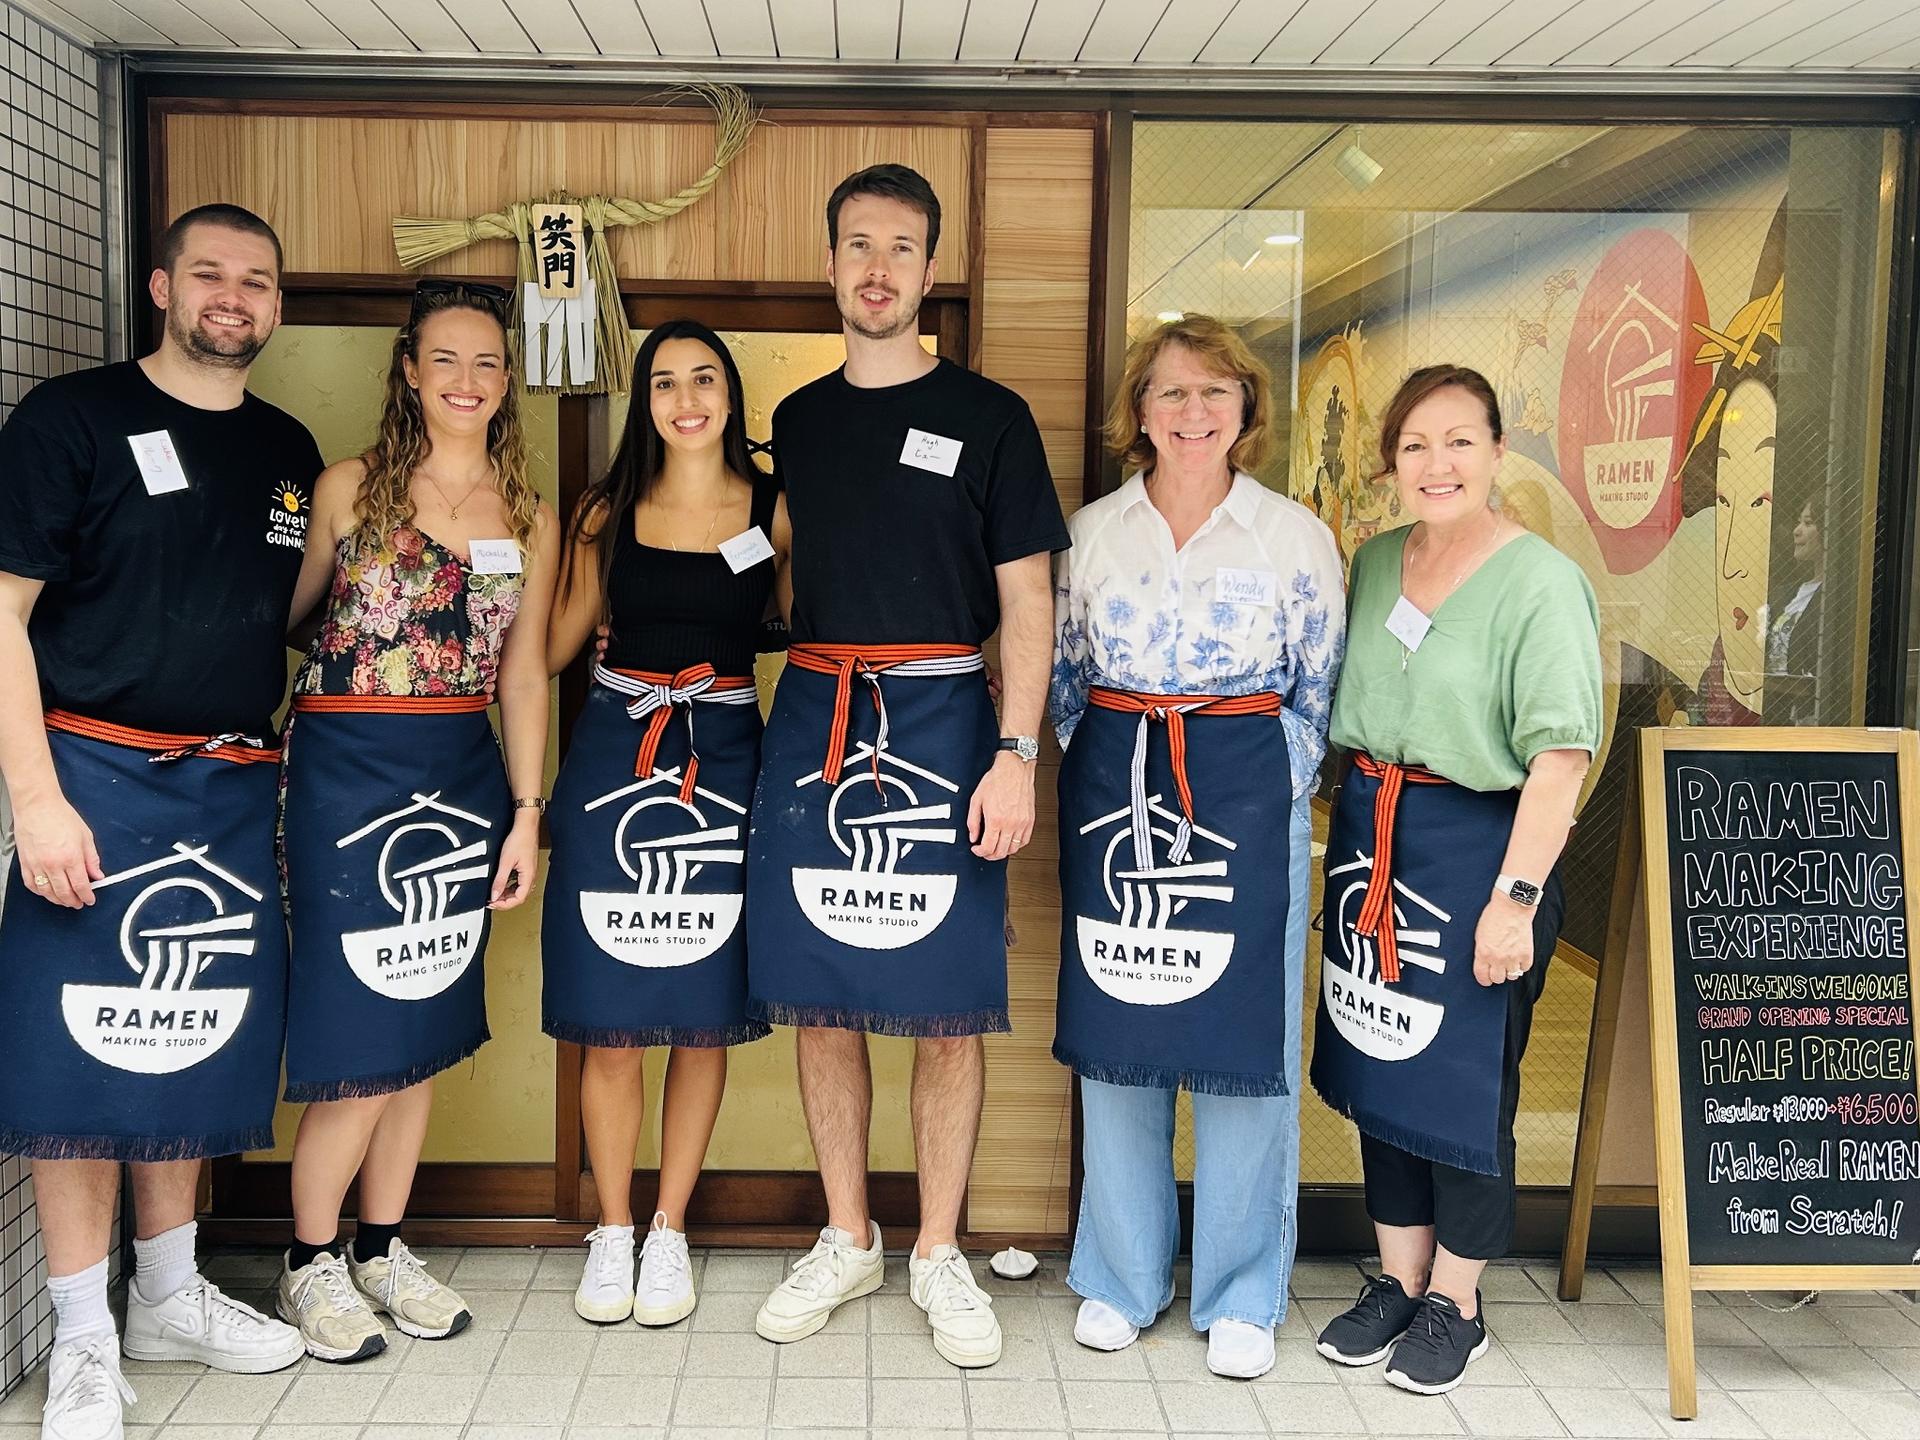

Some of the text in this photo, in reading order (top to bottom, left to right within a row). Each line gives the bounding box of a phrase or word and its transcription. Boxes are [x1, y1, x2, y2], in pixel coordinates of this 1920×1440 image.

[541, 212, 576, 289] 笑門
[1597, 460, 1654, 485] RAMEN
[1600, 492, 1649, 501] MAKING STUDIO
[289, 528, 302, 536] for
[1222, 573, 1265, 600] Wendy
[1677, 766, 1889, 841] RAMEN
[1684, 850, 1902, 911] MAKING
[821, 888, 926, 912] RAMEN
[607, 911, 714, 930] RAMEN
[828, 914, 919, 927] MAKING STUDIO
[377, 930, 469, 967] RAMEN
[614, 936, 706, 945] MAKING STUDIO
[1687, 914, 1906, 960] EXPERIENCE
[1094, 939, 1201, 969] RAMEN
[386, 957, 462, 981] MAKING STUDIO
[1100, 967, 1193, 984] MAKING STUDIO
[1695, 974, 1908, 1001] WALK-INS WELCOME
[95, 1007, 218, 1030] RAMEN
[1332, 981, 1410, 1034] RAMEN
[1698, 1006, 1908, 1029] GRAND OPENING SPECIAL
[1336, 1008, 1403, 1046] MAKING STUDIO
[102, 1036, 207, 1047] MAKING STUDIO
[1701, 1036, 1914, 1085] HALF PRICE!
[1705, 1097, 1771, 1124] Regular
[1839, 1139, 1920, 1181] RAMEN
[1726, 1195, 1903, 1239] from Scratch!
